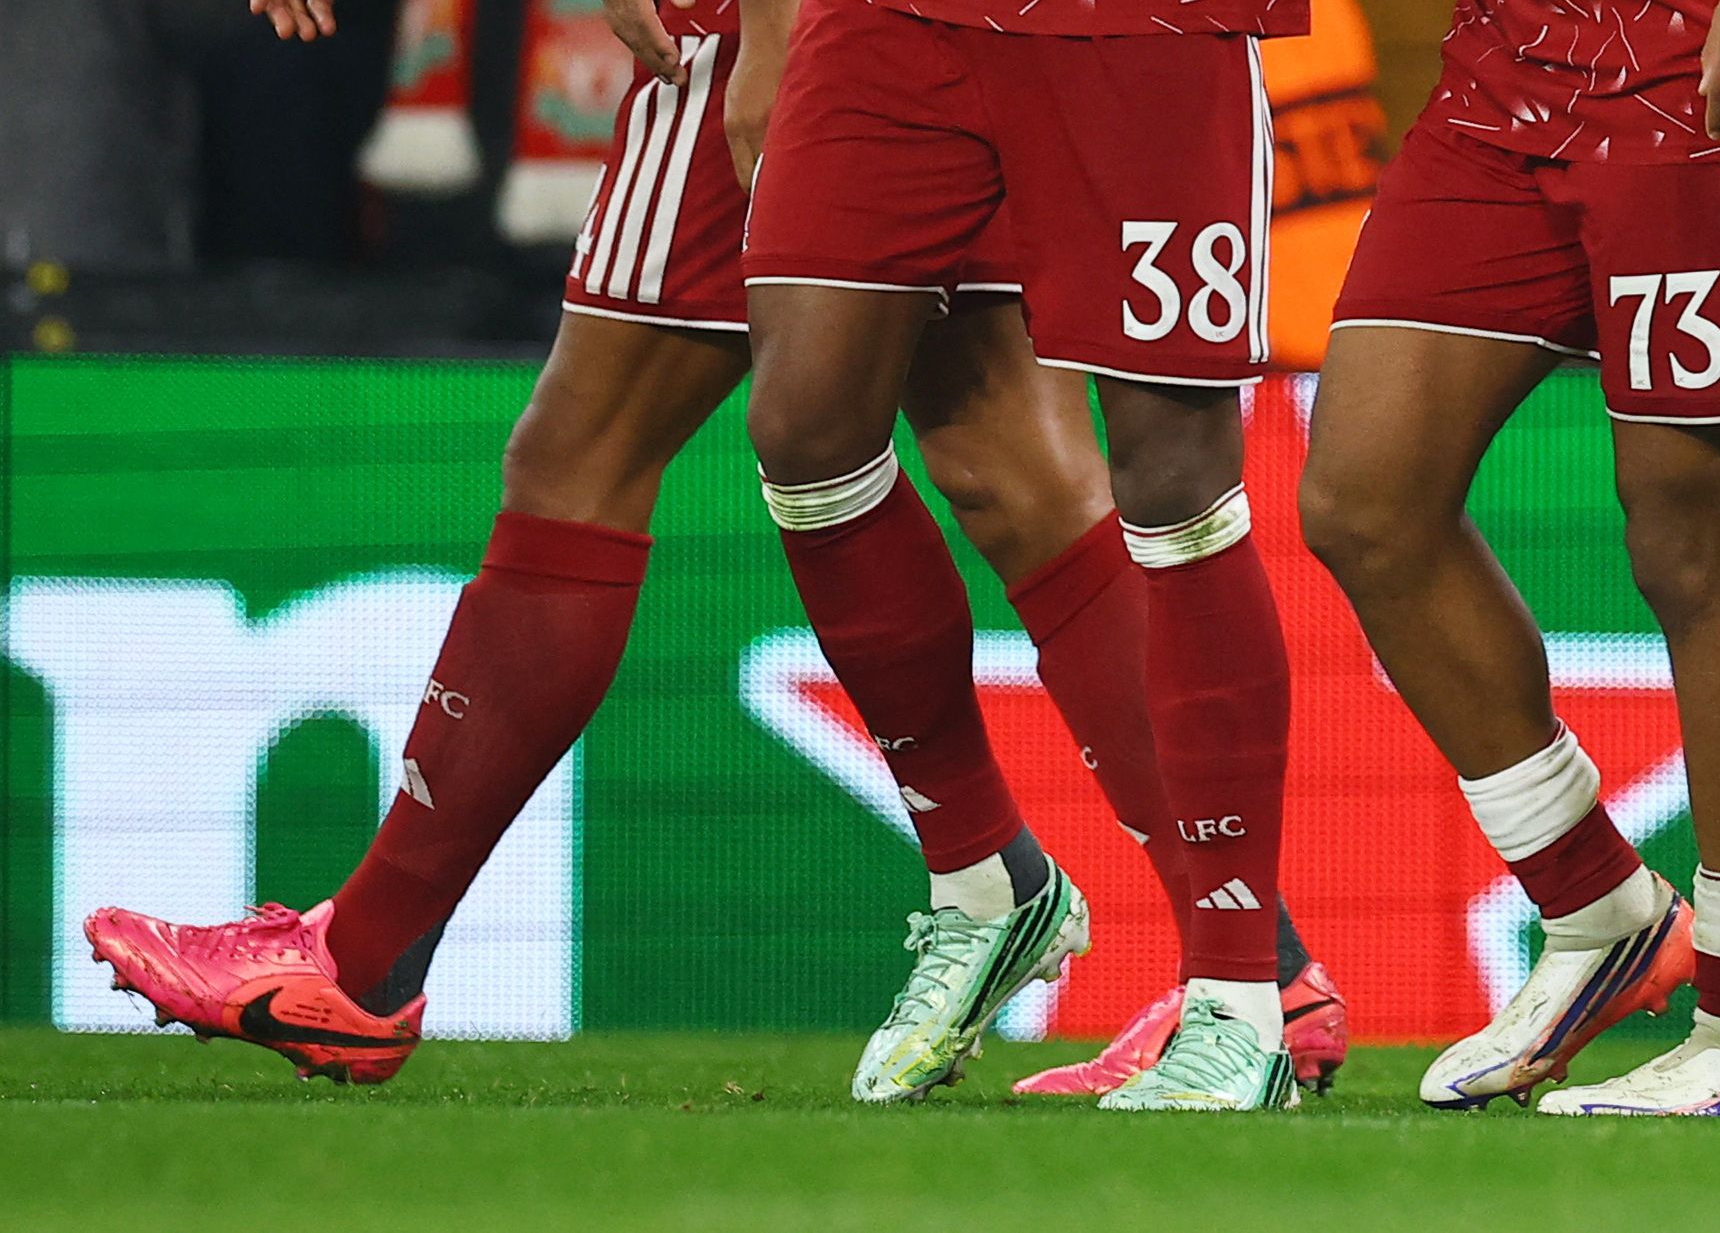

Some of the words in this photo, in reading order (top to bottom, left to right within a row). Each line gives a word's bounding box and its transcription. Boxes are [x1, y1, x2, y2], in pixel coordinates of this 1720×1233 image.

[1122, 221, 1247, 343] 38
[424, 679, 469, 719] FC
[1177, 815, 1247, 842] LFC
